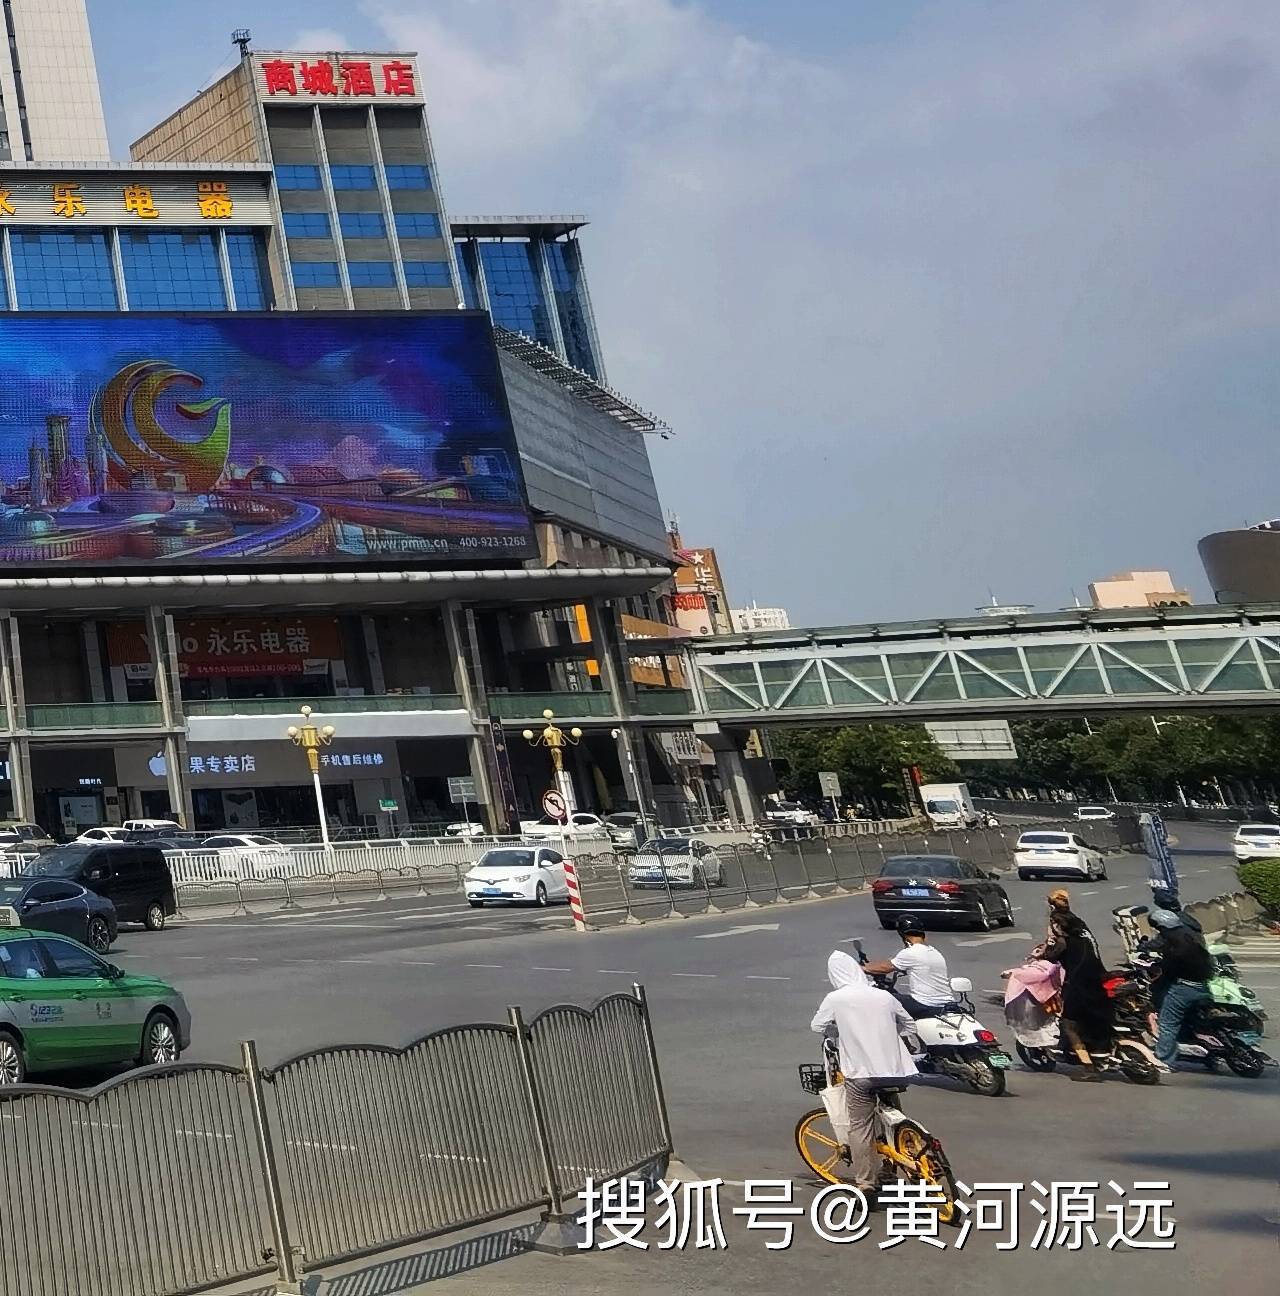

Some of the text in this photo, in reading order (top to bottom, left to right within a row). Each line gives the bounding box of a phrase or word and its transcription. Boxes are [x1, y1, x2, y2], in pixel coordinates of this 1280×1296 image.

[262, 59, 416, 96] 商城酒店
[459, 536, 526, 548] 400-923-1268
[207, 627, 311, 656] 永乐电器
[320, 753, 384, 766] 手机售后维修
